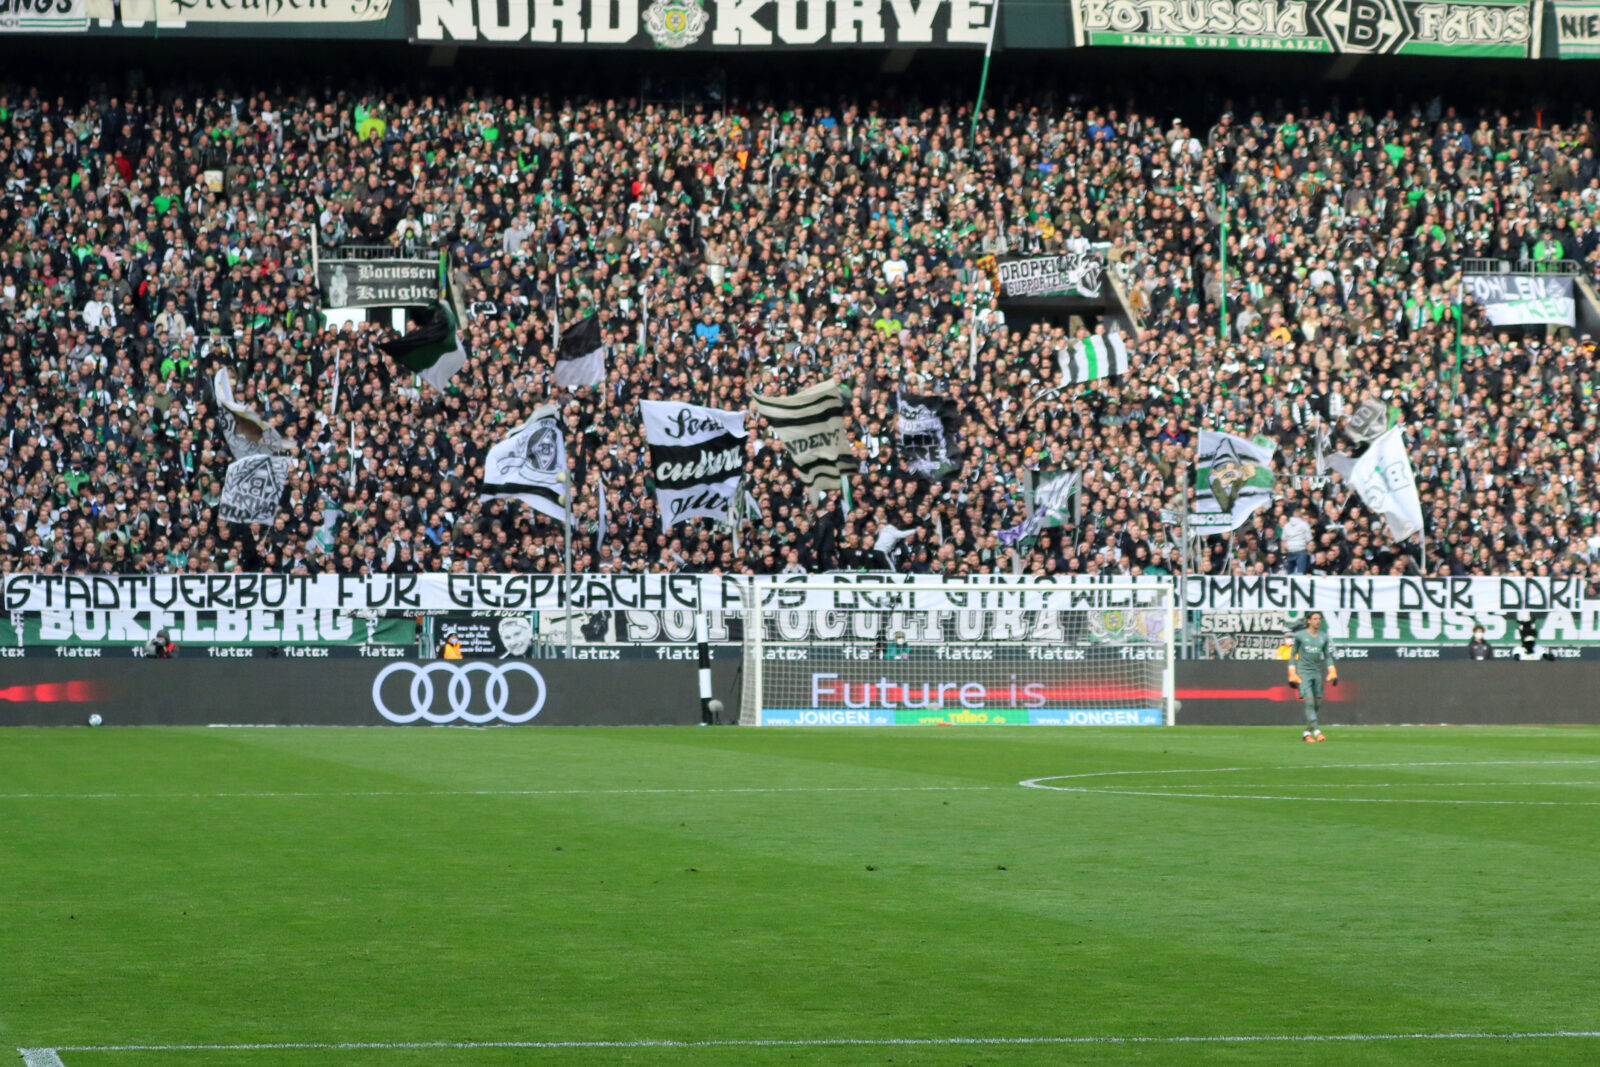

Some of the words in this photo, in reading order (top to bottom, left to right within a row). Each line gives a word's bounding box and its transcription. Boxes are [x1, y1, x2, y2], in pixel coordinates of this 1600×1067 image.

[417, 0, 638, 42] NORD
[711, 0, 992, 44] KURVE
[1084, 0, 1307, 39] BORUSSIA
[1415, 5, 1531, 44] FANS
[1123, 35, 1186, 46] IMMER
[1195, 36, 1230, 48] UND
[357, 264, 437, 281] Borussen
[1000, 254, 1077, 282] DROPKIK
[355, 284, 438, 300] Knights
[6, 574, 318, 609] STADTVERBOT
[338, 573, 421, 608] FÜR
[449, 574, 698, 609] GESPRÄCHE
[1340, 577, 1374, 609] IN
[1400, 577, 1473, 609] DER
[1500, 576, 1581, 609] DDR!
[1200, 613, 1284, 633] SERVICE
[56, 647, 101, 657] flatex
[208, 647, 253, 657] flatex
[283, 647, 329, 657] flatex
[359, 647, 405, 657] flatex
[750, 648, 807, 660] latex
[936, 647, 993, 660] flatex
[1028, 647, 1085, 660] flatex
[1120, 648, 1176, 660] flate
[1396, 647, 1440, 658] flatex
[811, 672, 987, 709] Future
[1009, 672, 1047, 709] is
